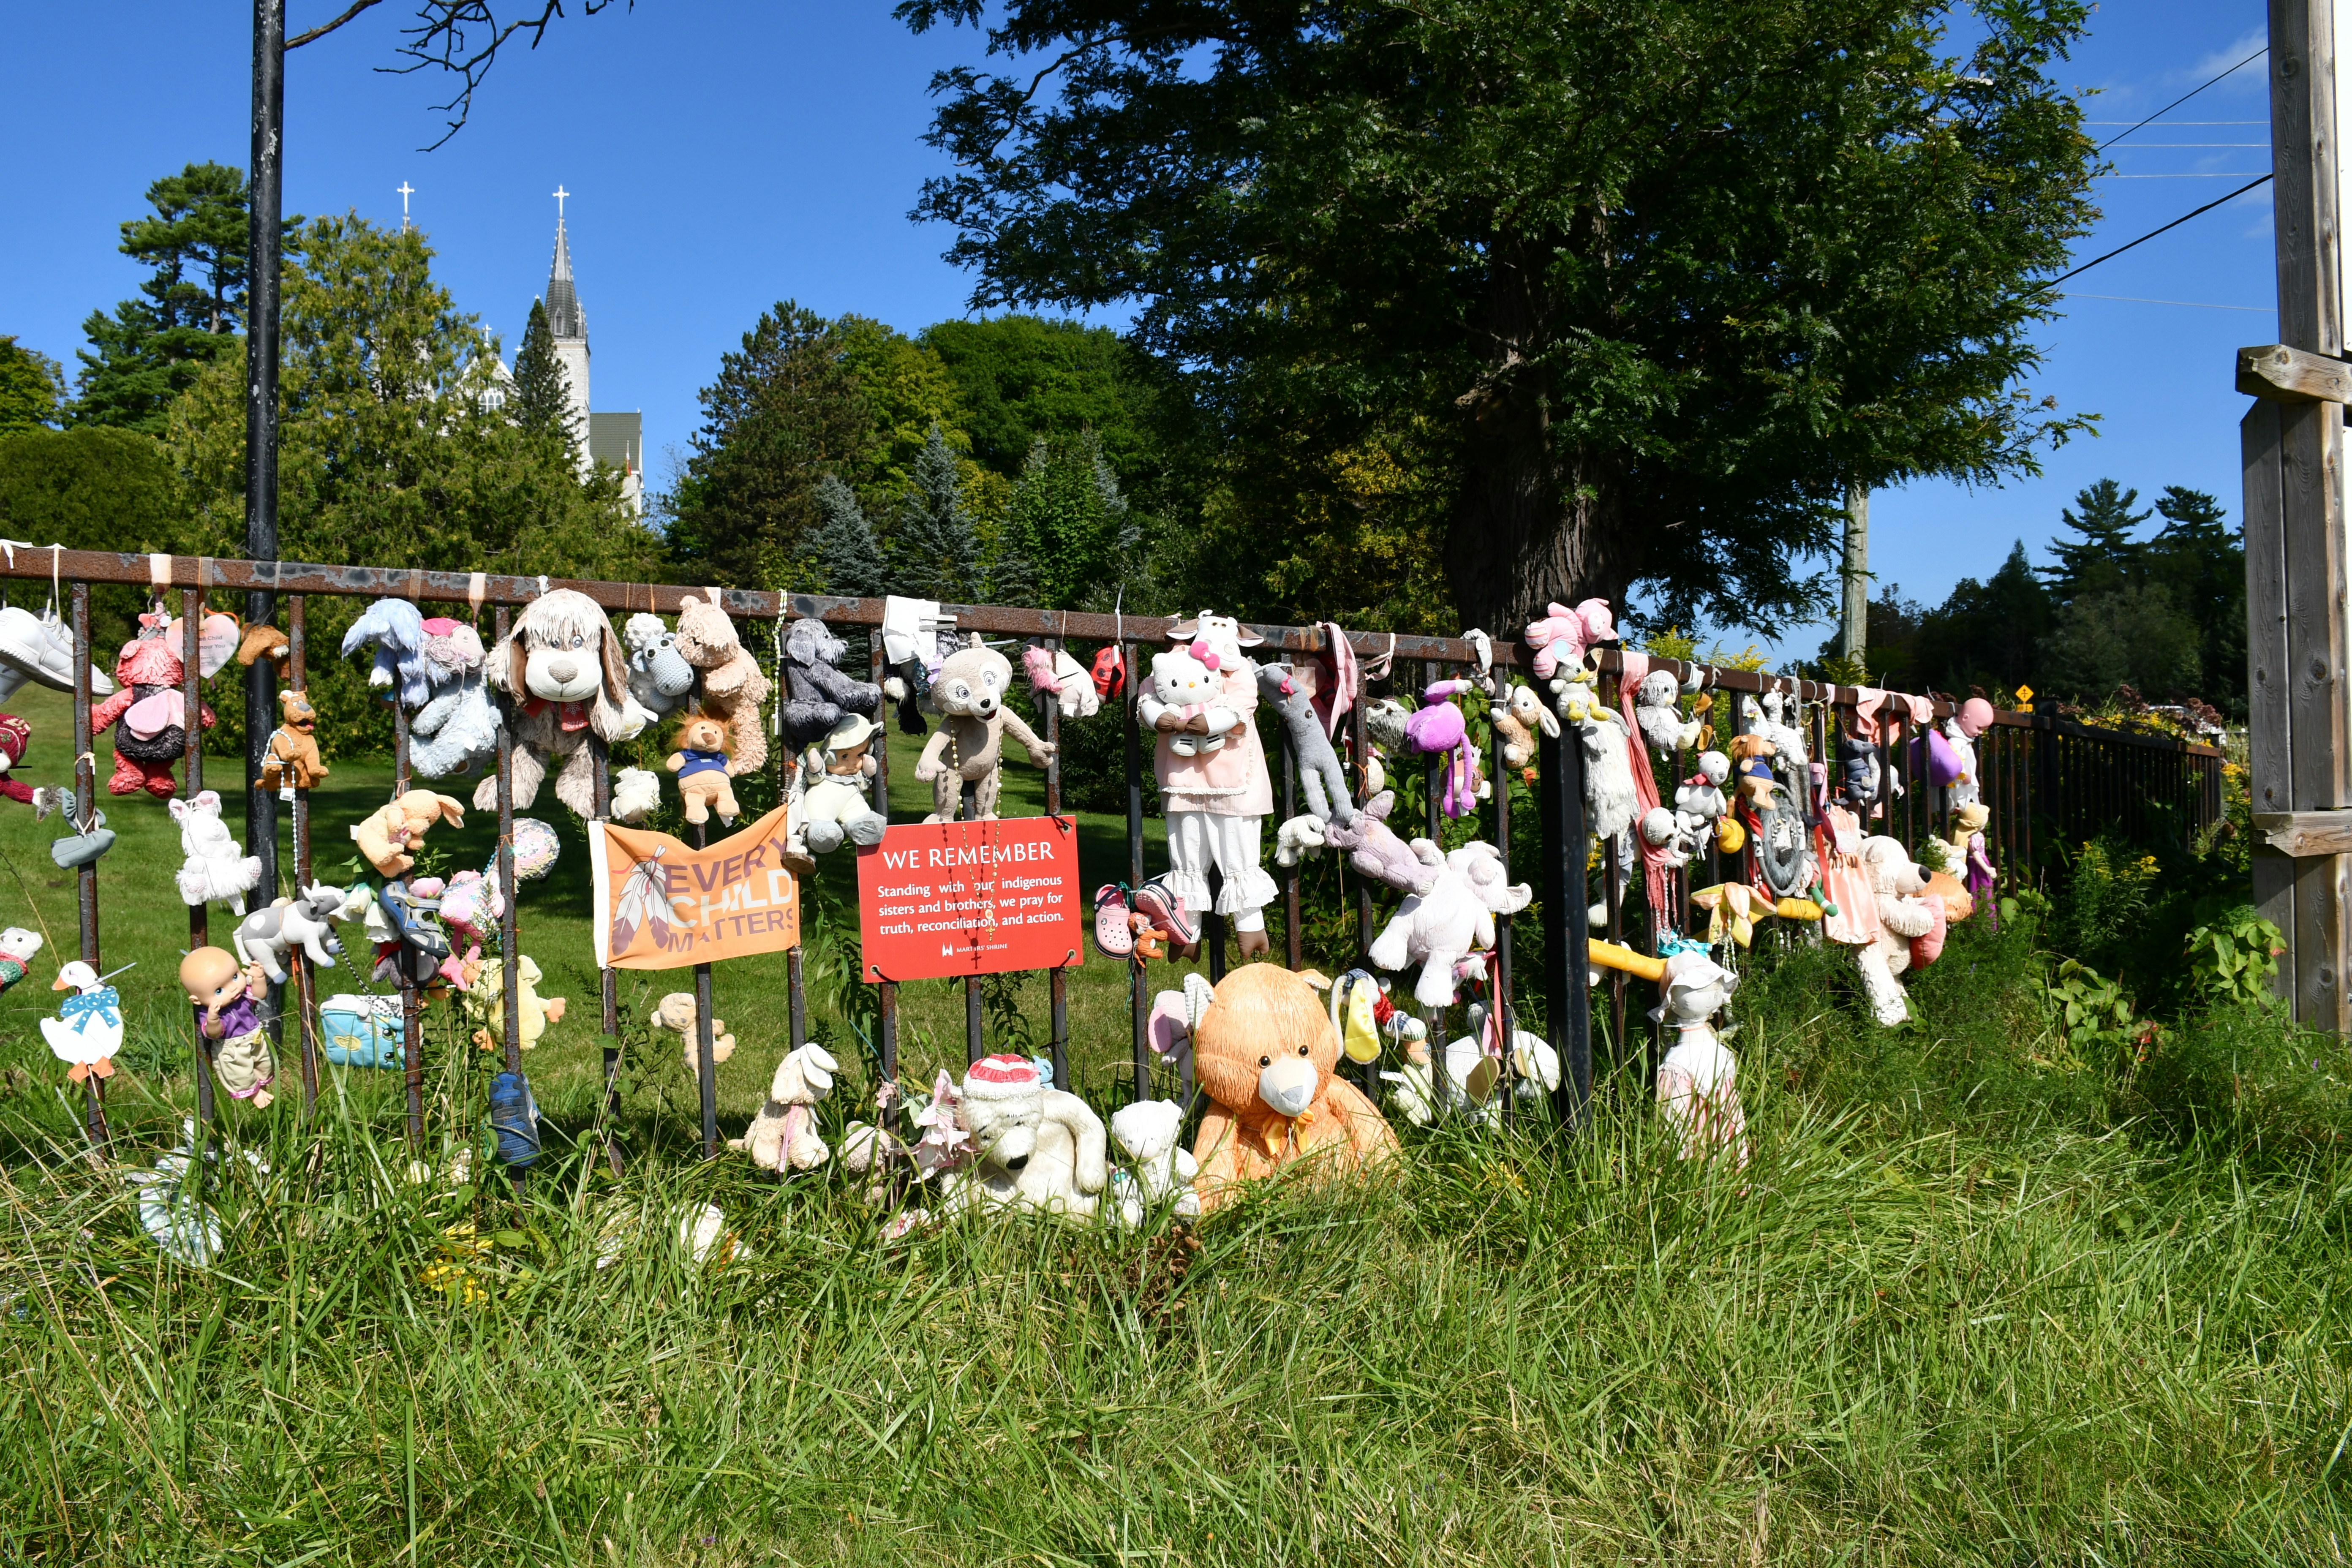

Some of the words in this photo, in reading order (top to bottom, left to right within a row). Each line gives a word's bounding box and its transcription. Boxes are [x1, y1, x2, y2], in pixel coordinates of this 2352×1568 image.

[567, 719, 584, 729] 2016
[664, 837, 787, 893] EVERY
[883, 849, 920, 870] WE
[929, 841, 1055, 867] REMEMBER
[666, 868, 792, 928] CHILD
[877, 883, 931, 898] Standing
[939, 880, 965, 893] with
[974, 881, 995, 891] our
[1002, 876, 1062, 890] indigenous
[879, 904, 915, 916] sisters
[918, 900, 941, 914] and
[944, 898, 996, 912] brothers,
[999, 898, 1016, 907] we
[1019, 896, 1044, 909] pray
[1047, 892, 1063, 904] for
[879, 921, 914, 935] truth,
[917, 917, 998, 932] reconciliation,
[1002, 912, 1024, 926] and
[1026, 911, 1064, 924] action.
